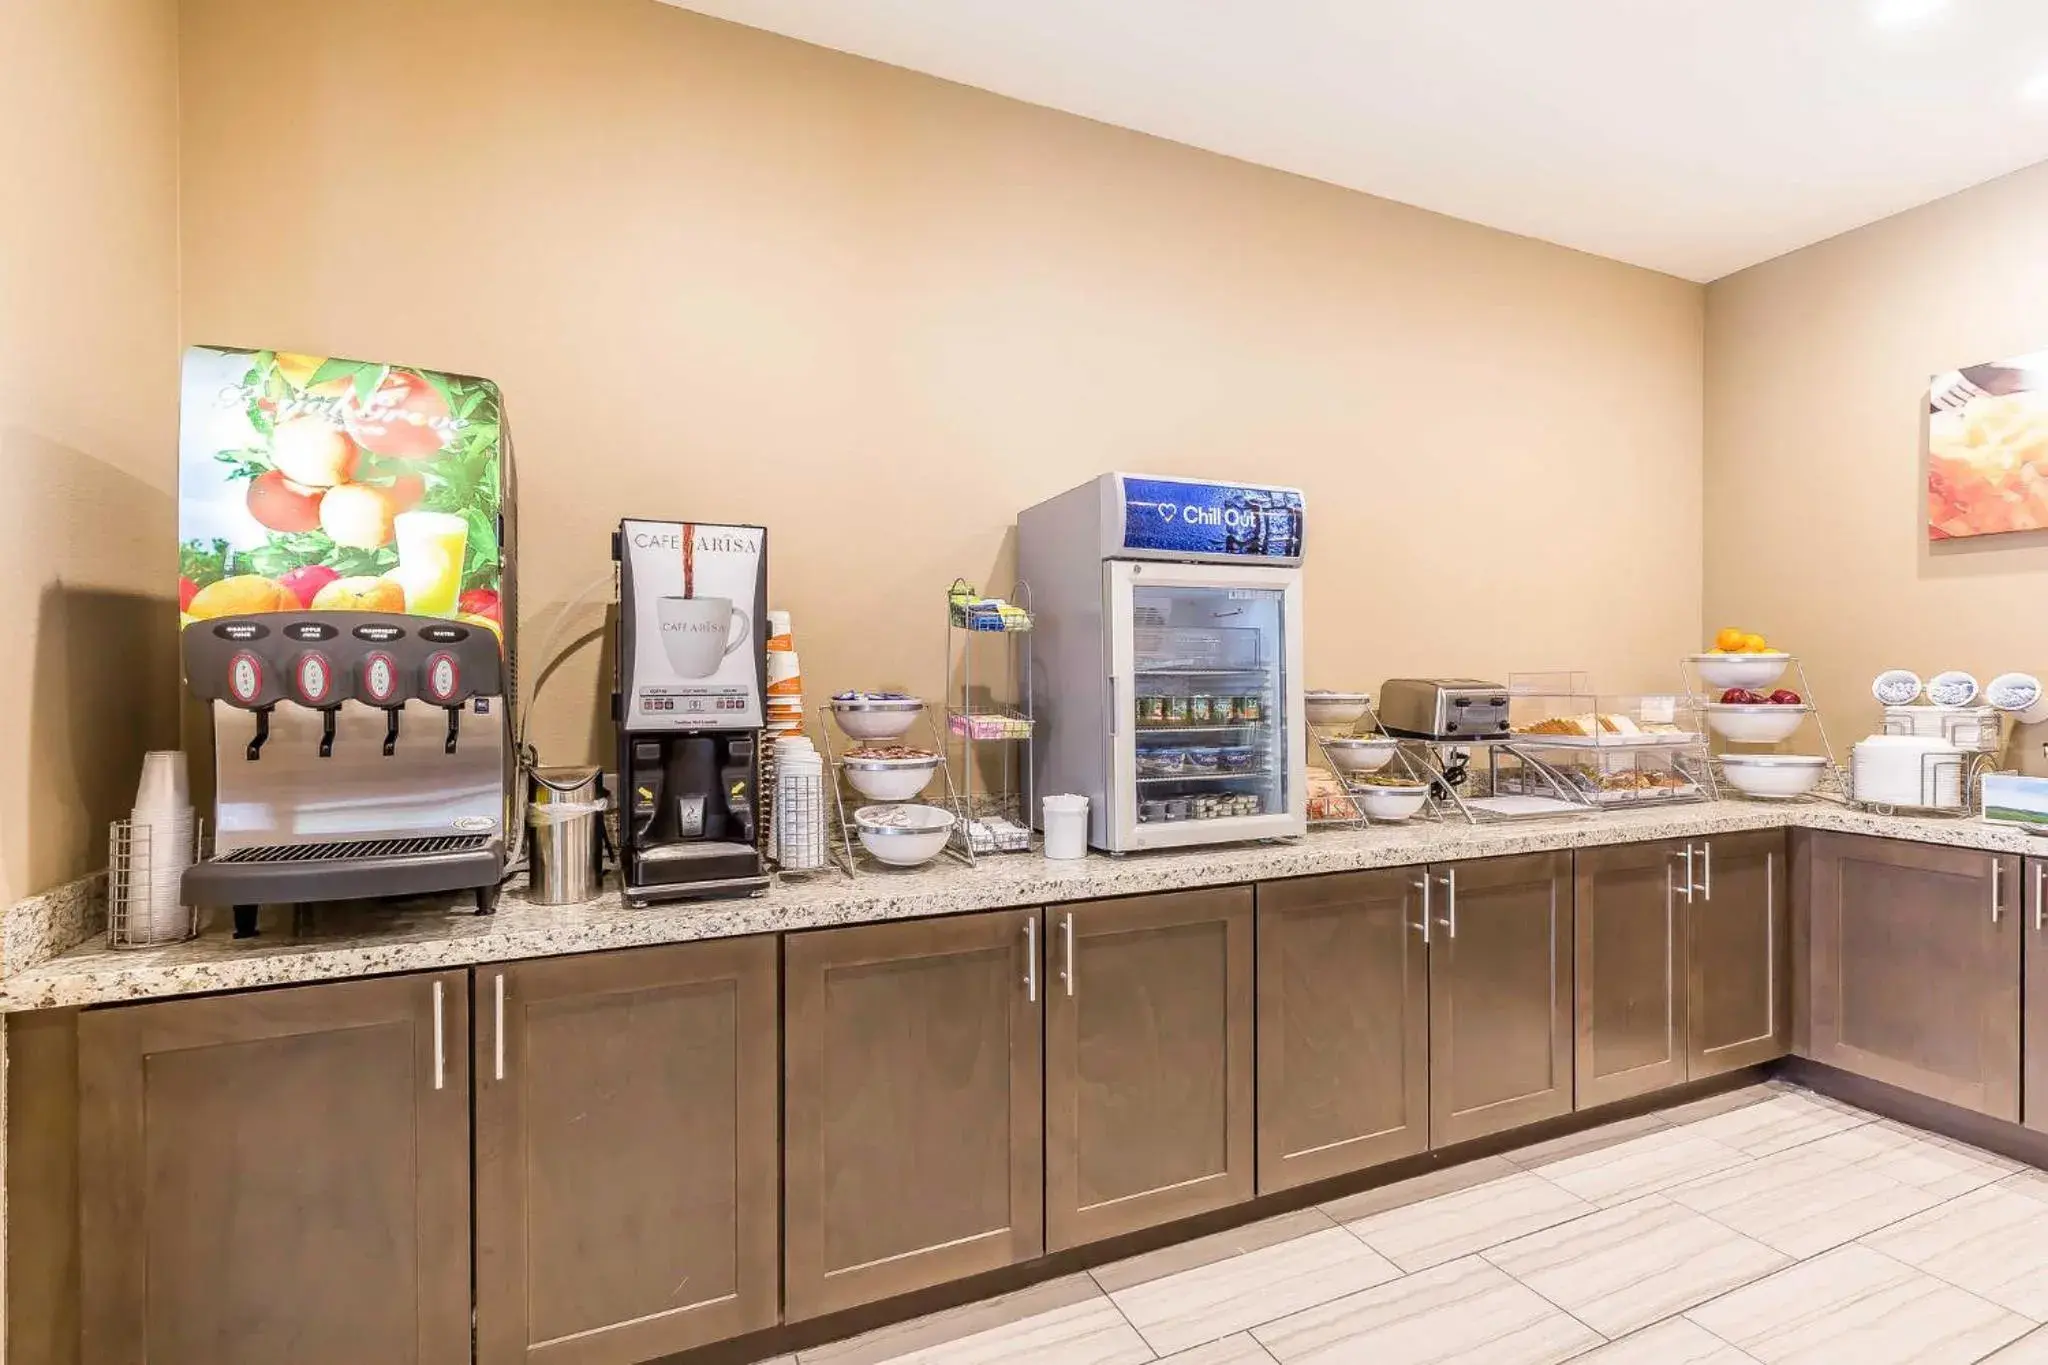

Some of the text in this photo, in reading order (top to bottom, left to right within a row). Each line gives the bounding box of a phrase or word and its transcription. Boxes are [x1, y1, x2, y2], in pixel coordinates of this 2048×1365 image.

[1183, 505, 1256, 527] Chill Out
[635, 533, 679, 549] CAFE
